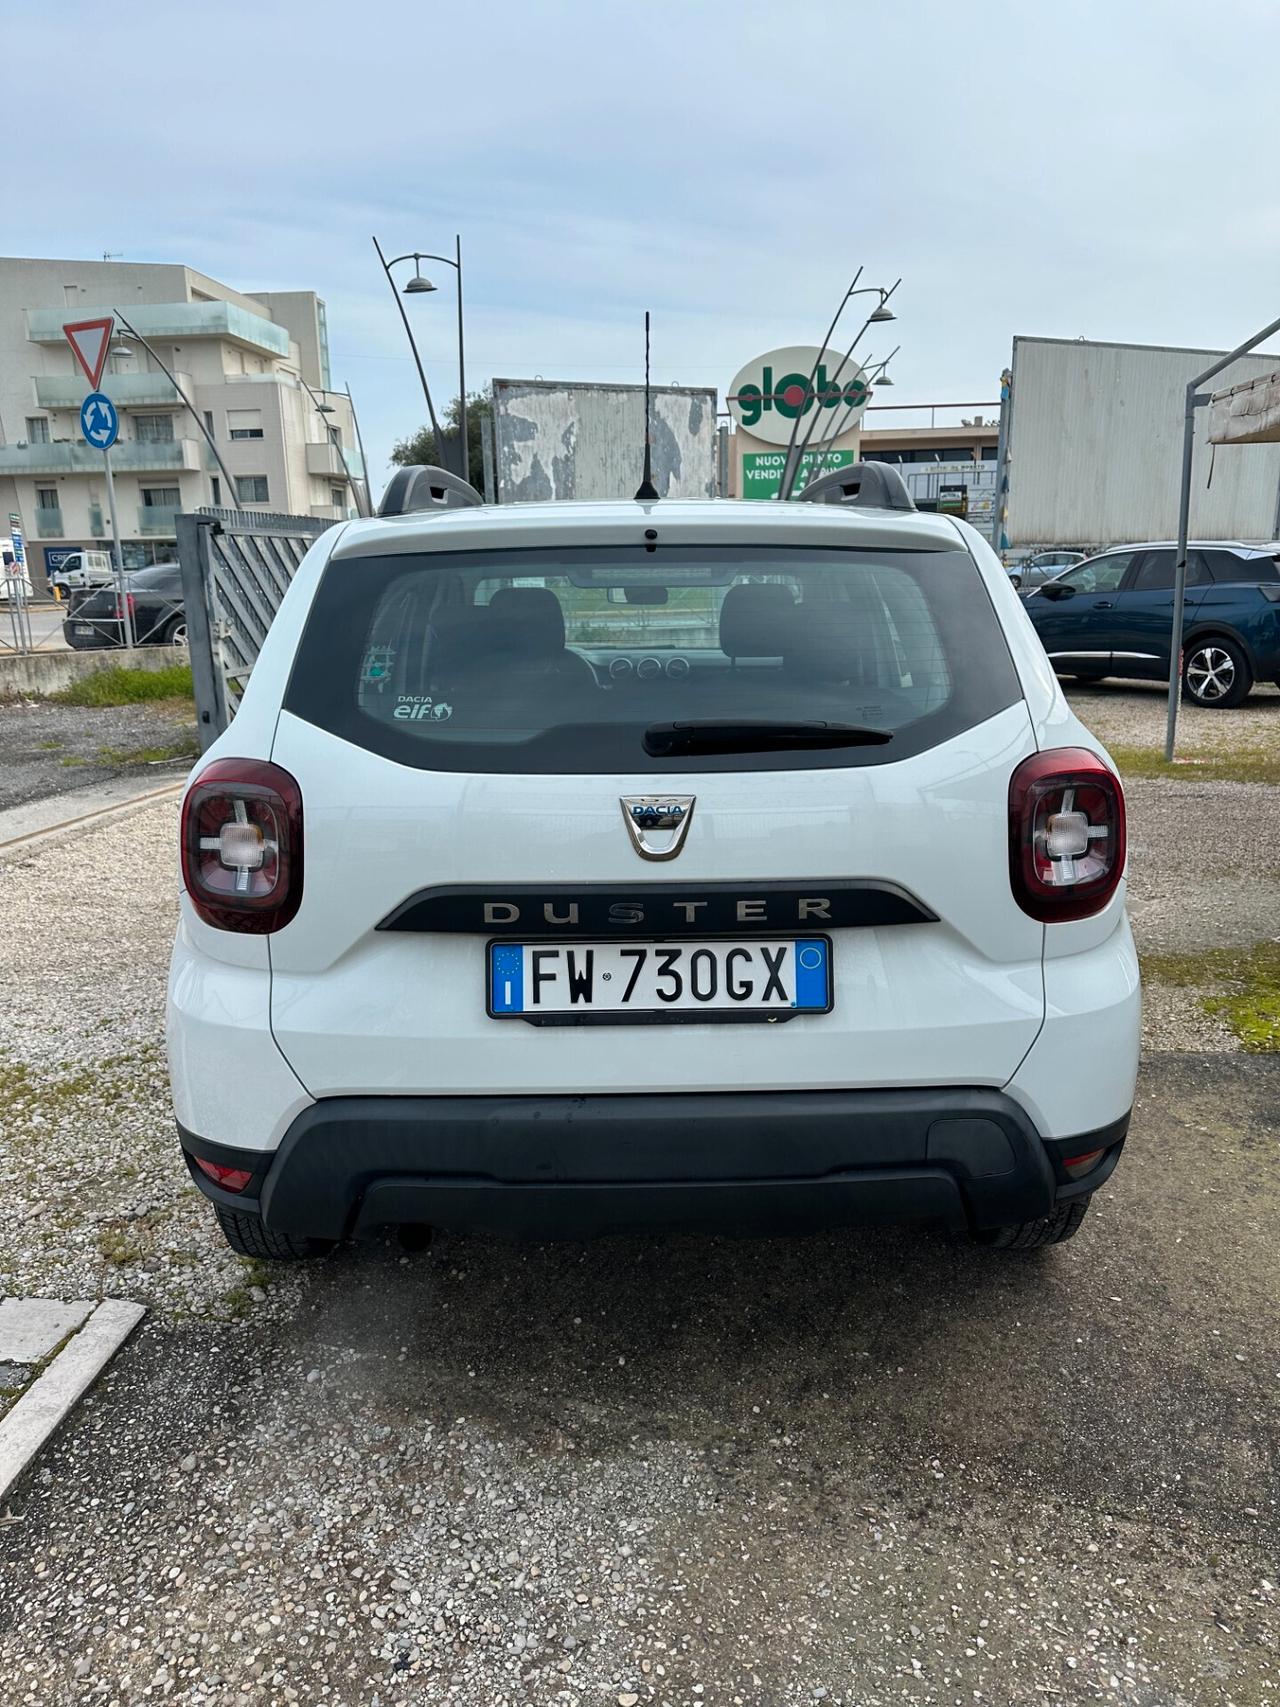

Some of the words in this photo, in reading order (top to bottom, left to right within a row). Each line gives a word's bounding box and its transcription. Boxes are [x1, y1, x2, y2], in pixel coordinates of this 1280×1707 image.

[738, 365, 866, 426] globo
[755, 455, 787, 466] NUOV
[393, 704, 432, 719] elf
[632, 806, 683, 815] DACIA
[483, 898, 832, 924] DUSTER
[532, 949, 594, 1004] FW
[619, 946, 789, 1003] 730GX
